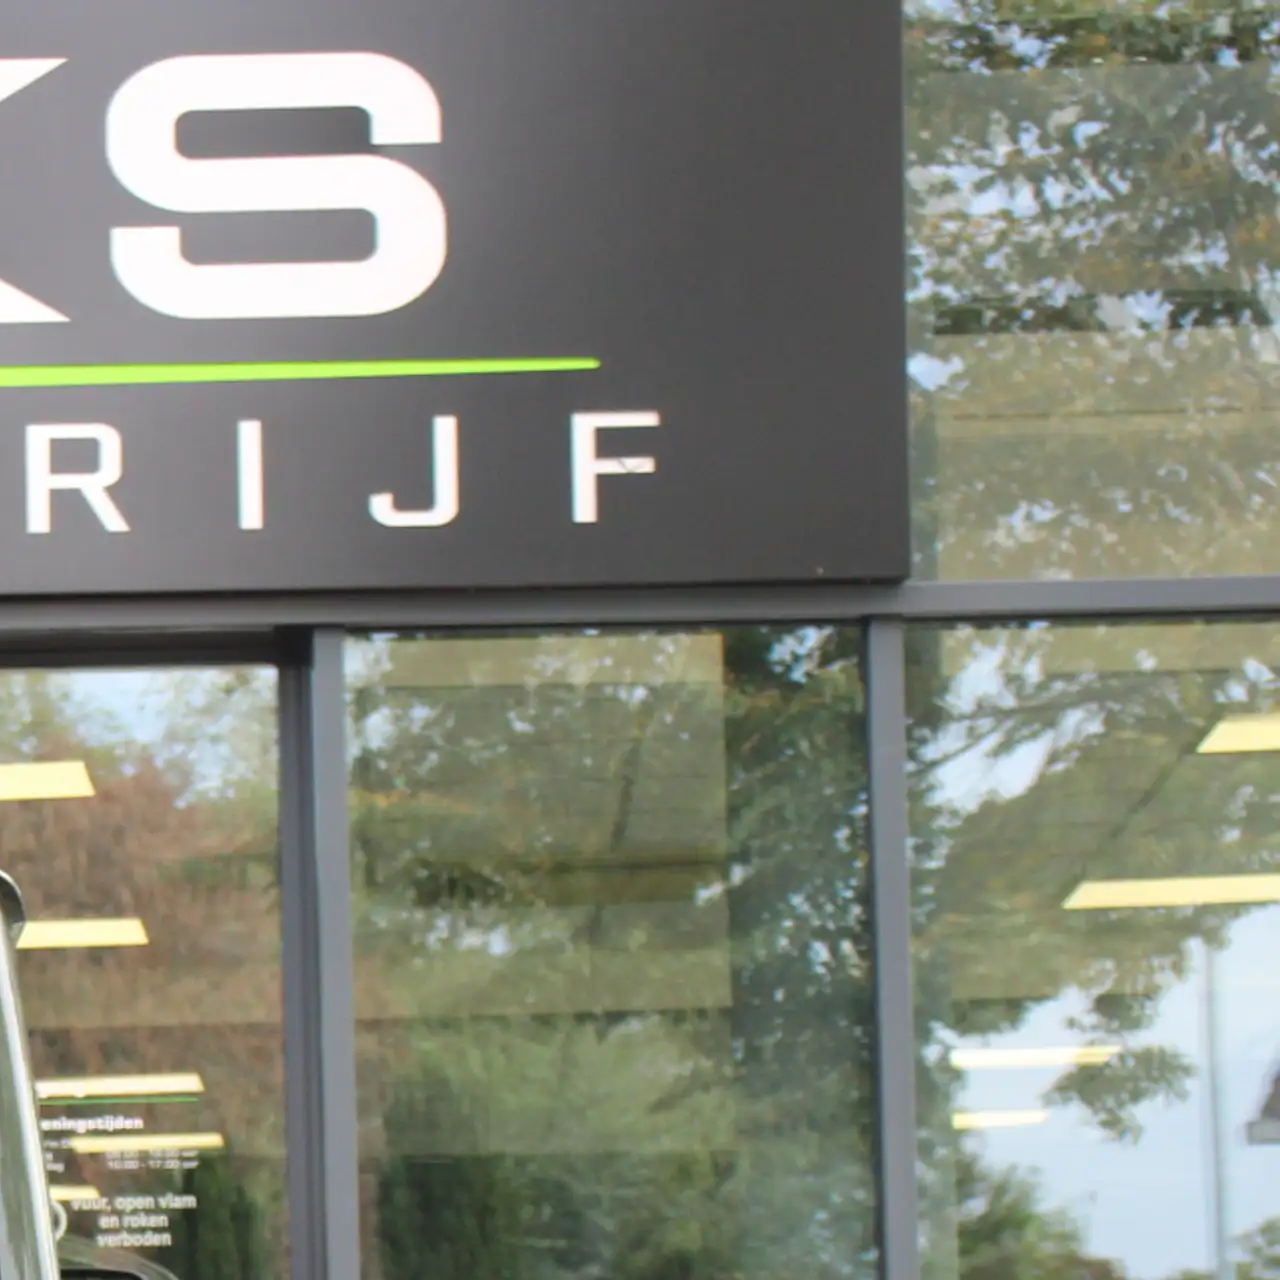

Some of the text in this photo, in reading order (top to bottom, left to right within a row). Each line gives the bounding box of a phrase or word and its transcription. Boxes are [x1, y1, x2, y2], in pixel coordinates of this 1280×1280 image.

[40, 1115, 144, 1133] eningstijden
[114, 1196, 156, 1213] open
[157, 1193, 198, 1209] vlam
[98, 1213, 169, 1228] en roken
[96, 1231, 172, 1247] verboden
